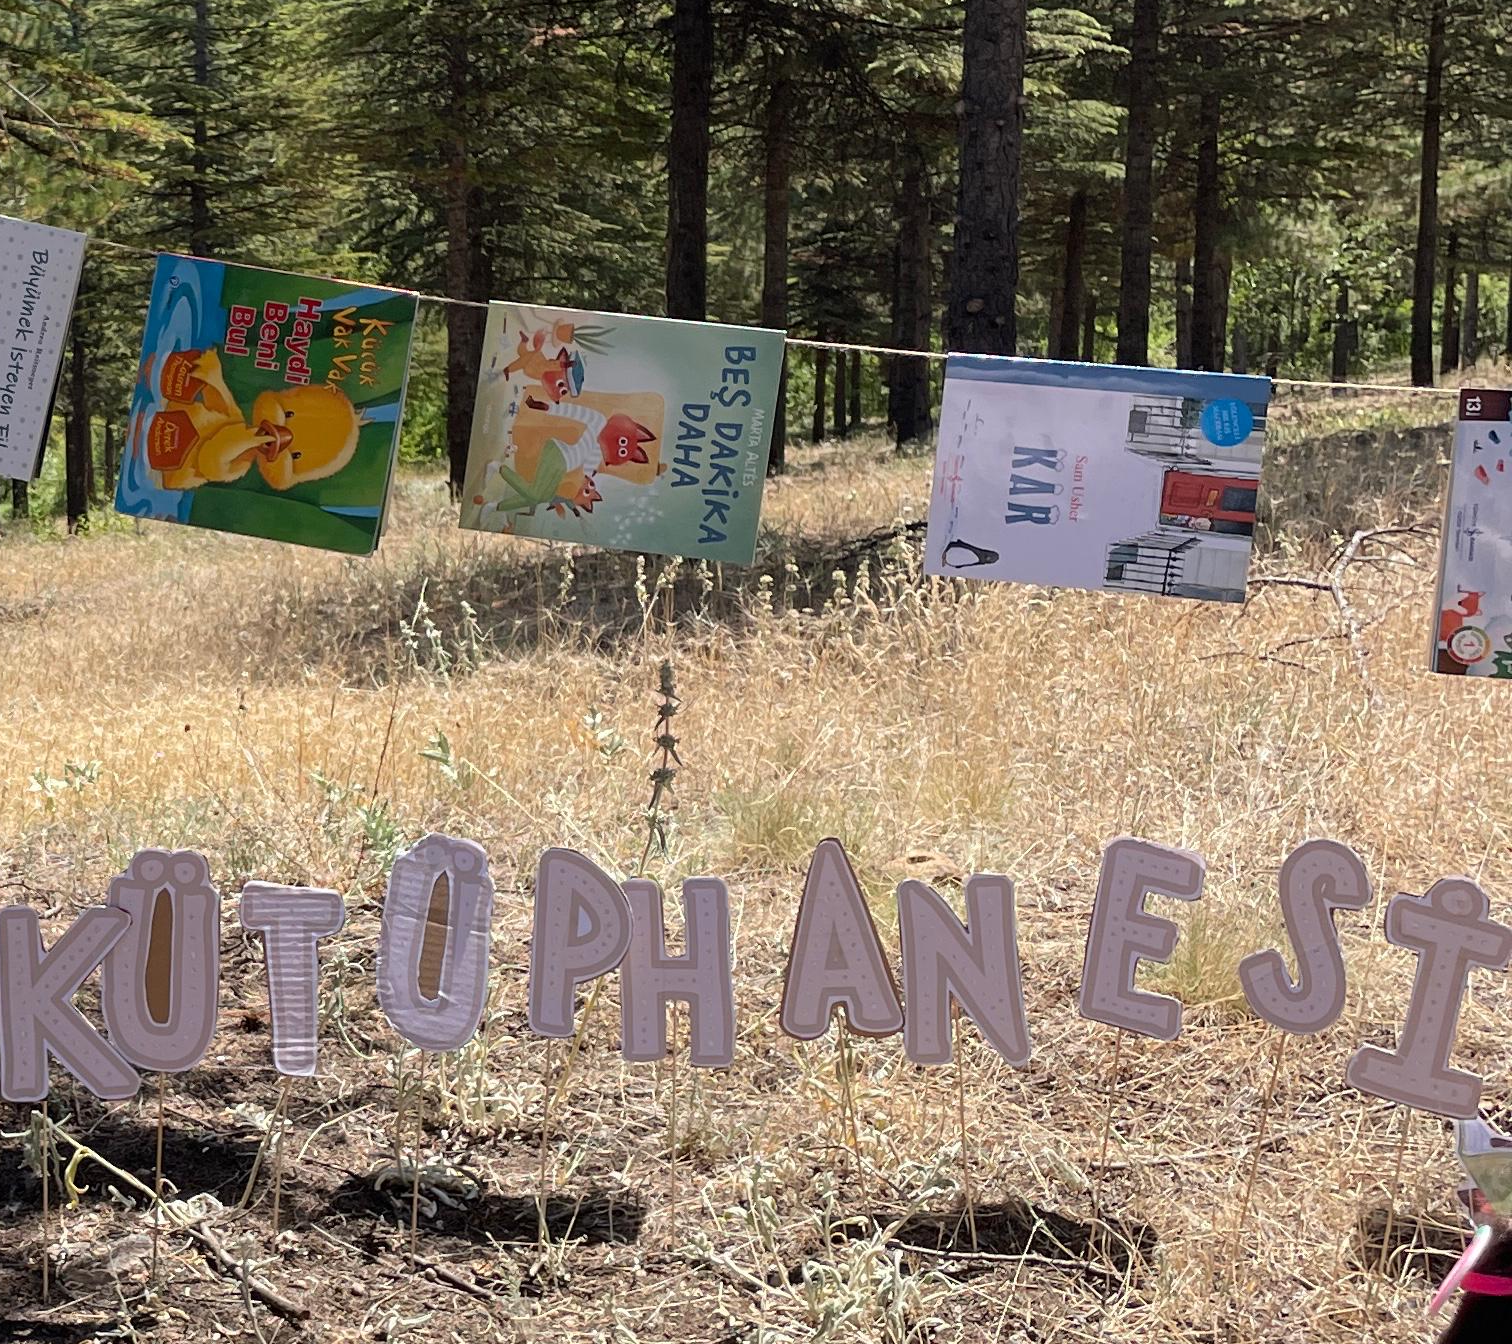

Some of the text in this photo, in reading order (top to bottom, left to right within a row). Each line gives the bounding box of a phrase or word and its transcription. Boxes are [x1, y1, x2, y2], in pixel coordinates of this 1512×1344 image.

[15, 248, 49, 342] Büyümek
[224, 305, 257, 356] Bul
[255, 300, 290, 371] Beni
[284, 296, 323, 386] Haydi
[323, 307, 358, 394] Vak Vak
[671, 403, 711, 488] DAHA
[697, 346, 757, 544] BEŞ DAKİKA
[748, 408, 766, 449] MARTA
[1005, 446, 1062, 526] KAR
[1068, 456, 1089, 523] Sam Usher
